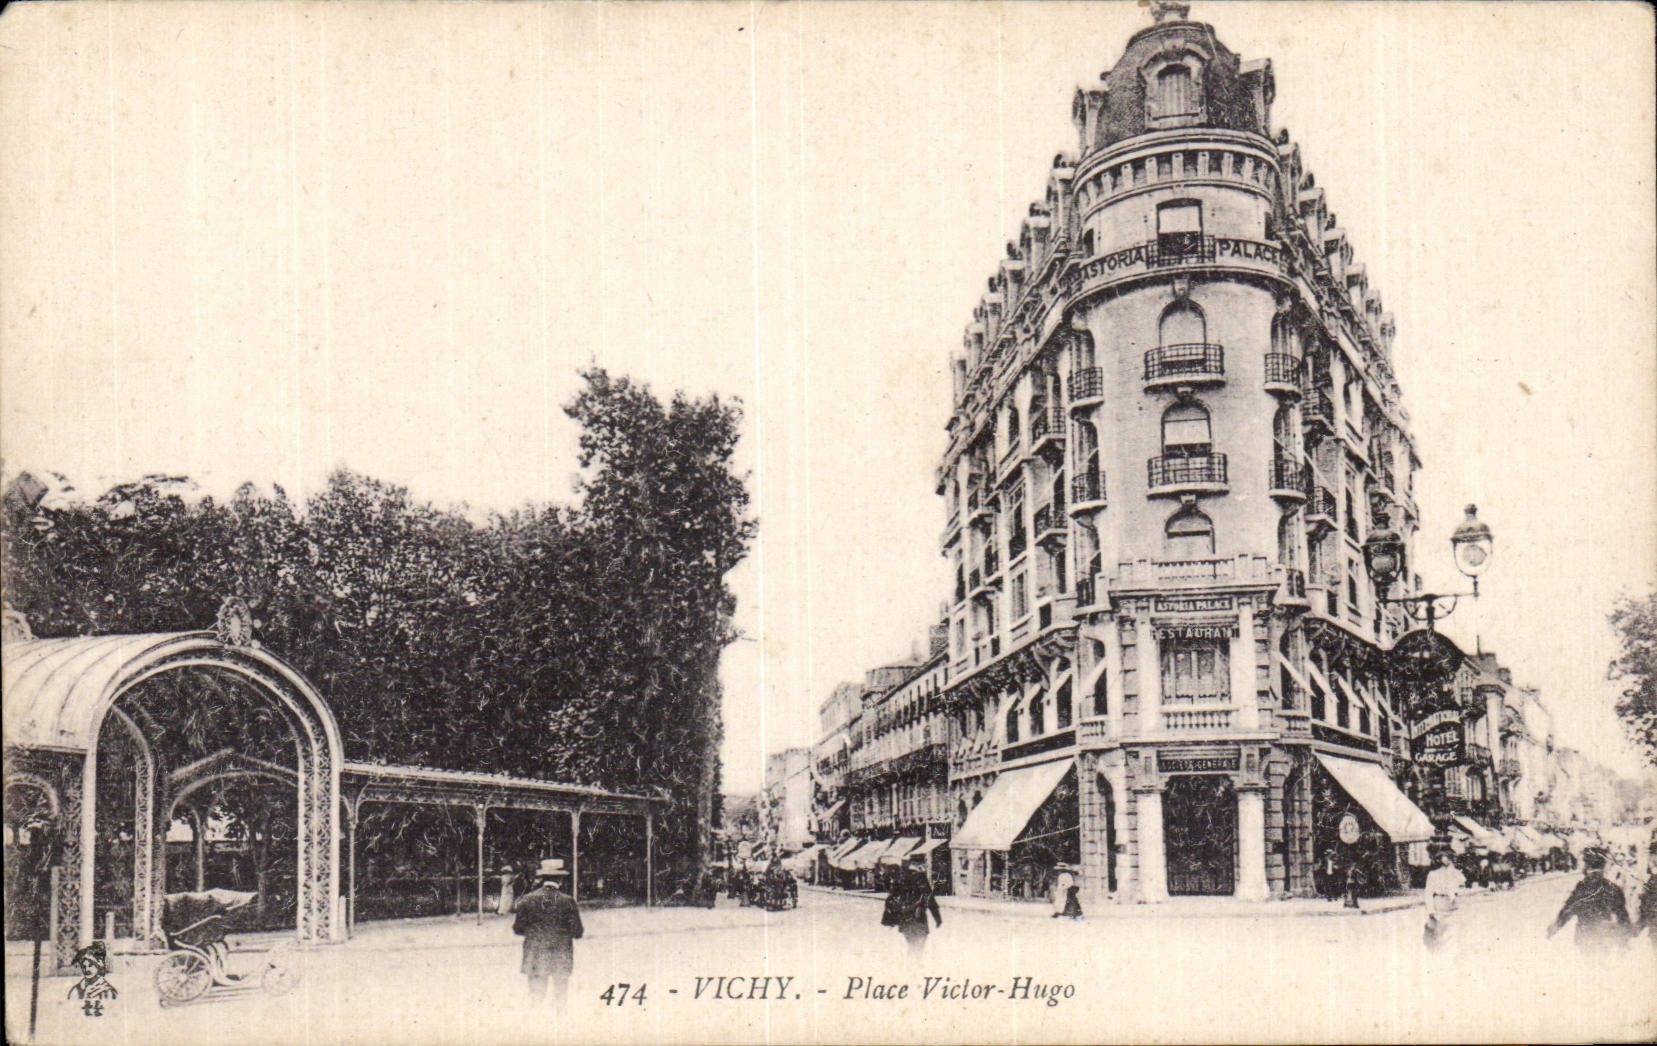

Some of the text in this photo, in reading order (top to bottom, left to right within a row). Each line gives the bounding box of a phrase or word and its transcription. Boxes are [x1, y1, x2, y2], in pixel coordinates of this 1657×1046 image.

[1082, 240, 1279, 280] ASTORIA PALACE
[1156, 600, 1231, 612] ASTORIA PALACE
[1415, 751, 1458, 765] GARAGE
